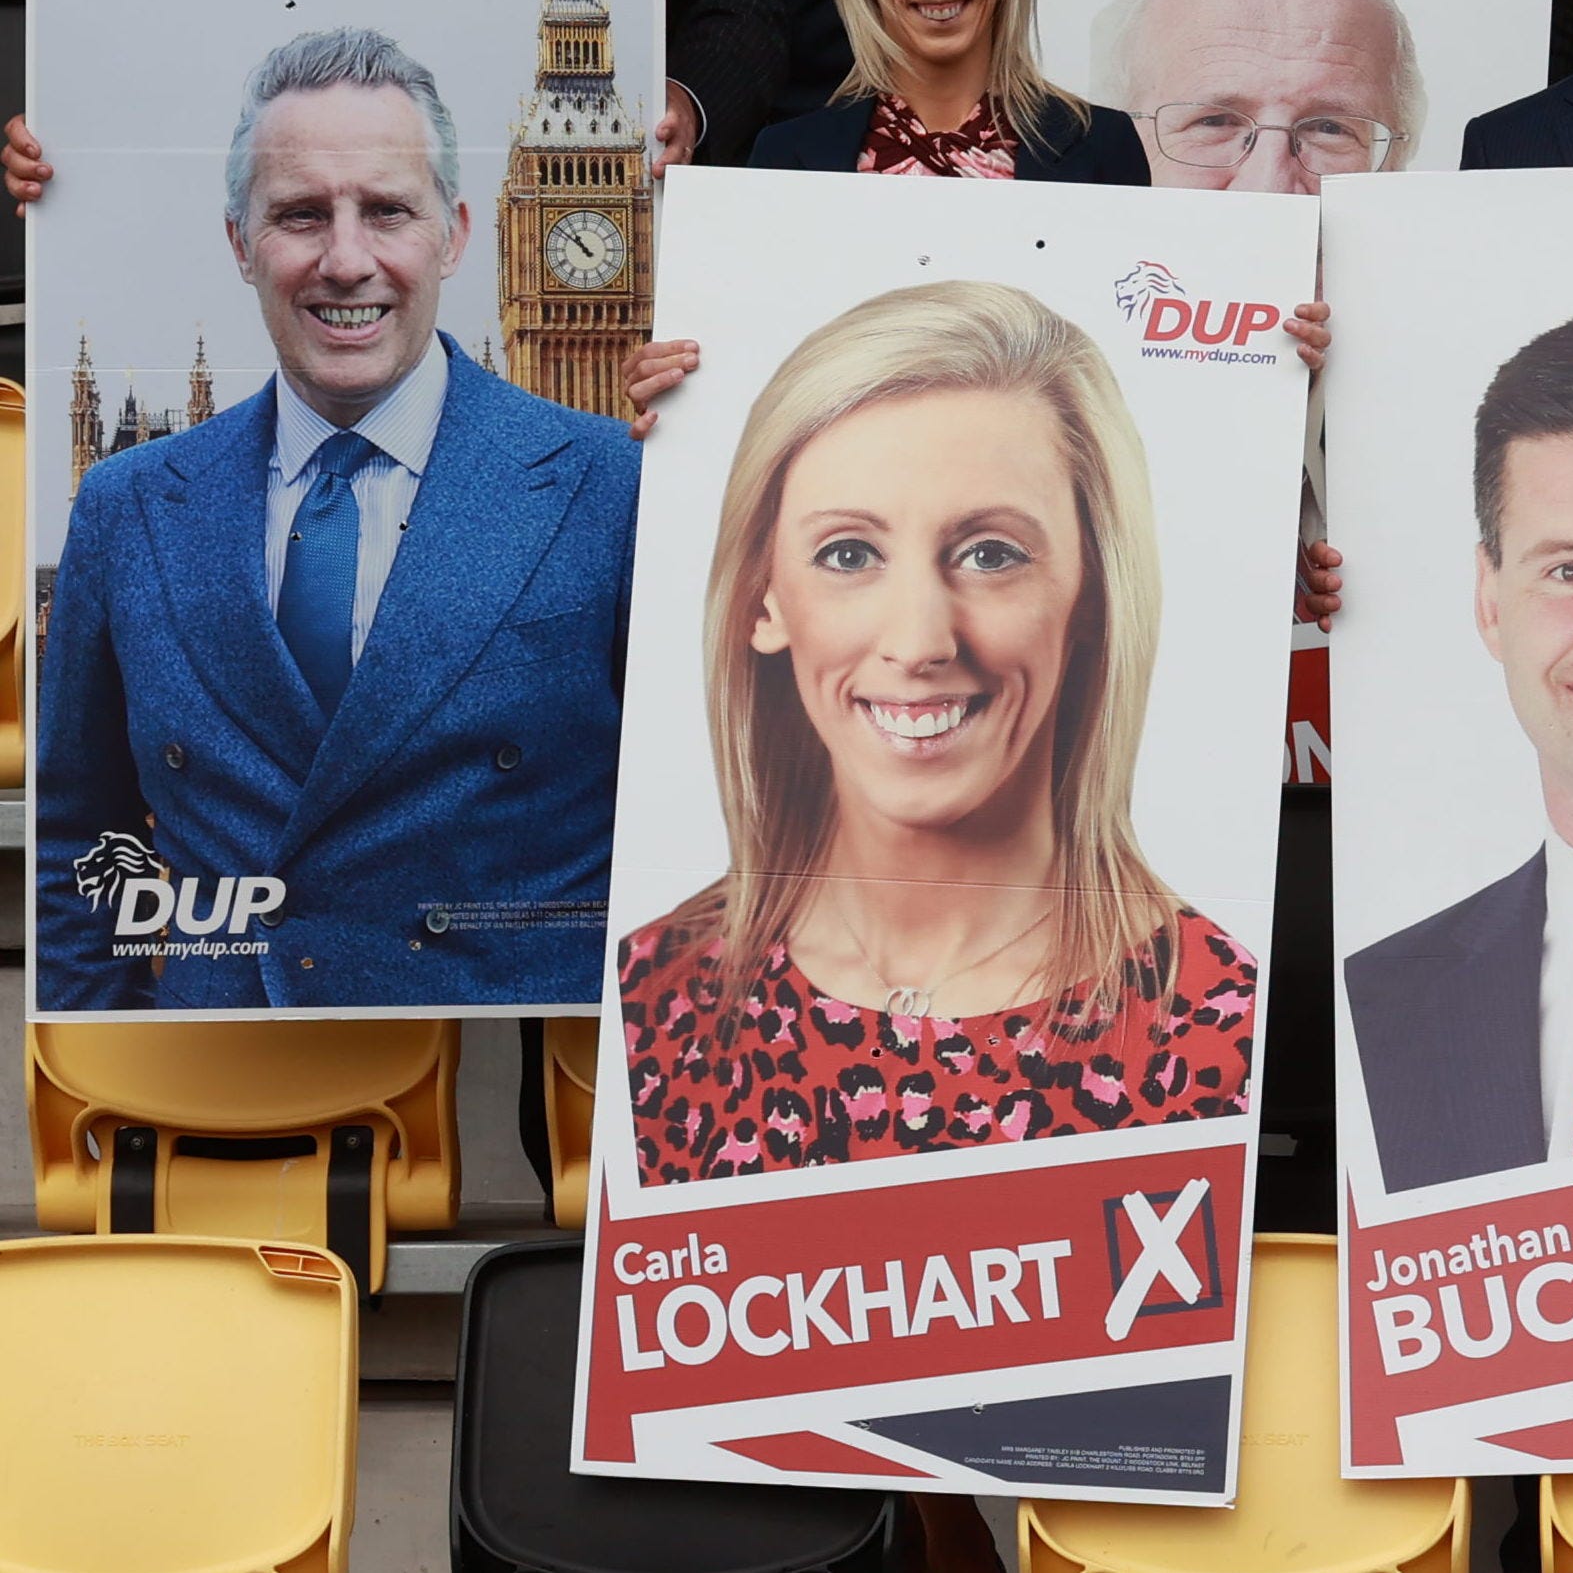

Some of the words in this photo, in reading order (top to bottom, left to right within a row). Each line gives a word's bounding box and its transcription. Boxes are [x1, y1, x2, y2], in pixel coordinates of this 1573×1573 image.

[1143, 299, 1280, 346] DUP
[1141, 346, 1277, 366] www.mydup.com
[115, 876, 287, 935] DUP
[113, 938, 269, 960] www.mydup.com
[613, 1233, 729, 1286] Carla
[1365, 1223, 1573, 1293] Jonathan
[615, 1239, 1072, 1373] LOCKHART
